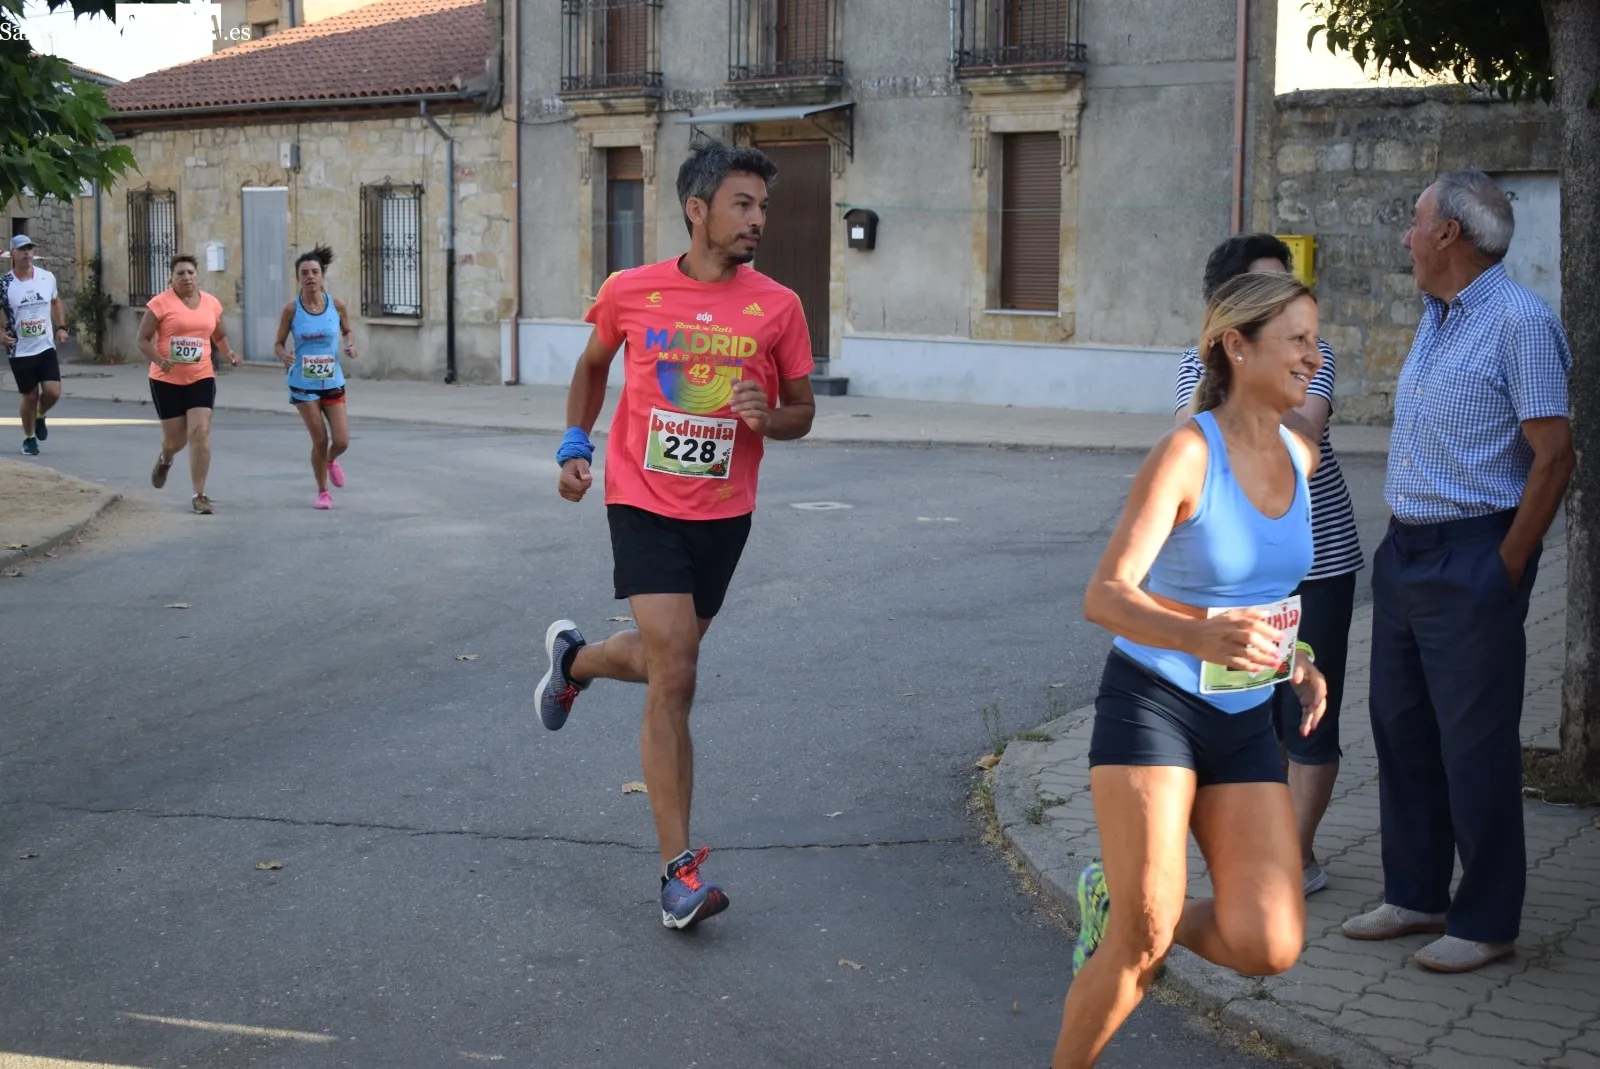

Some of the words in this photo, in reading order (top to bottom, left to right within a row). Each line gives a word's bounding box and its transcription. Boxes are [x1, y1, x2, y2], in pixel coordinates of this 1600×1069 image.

[696, 312, 713, 324] edp
[25, 324, 43, 334] 209
[674, 321, 701, 331] Rock
[711, 324, 733, 334] Roll
[645, 328, 758, 358] MADRID
[175, 346, 198, 358] 207
[658, 351, 743, 366] MARATHON
[309, 364, 330, 375] 224
[688, 363, 711, 379] 42
[650, 414, 735, 441] bedunia
[663, 435, 717, 464] 228
